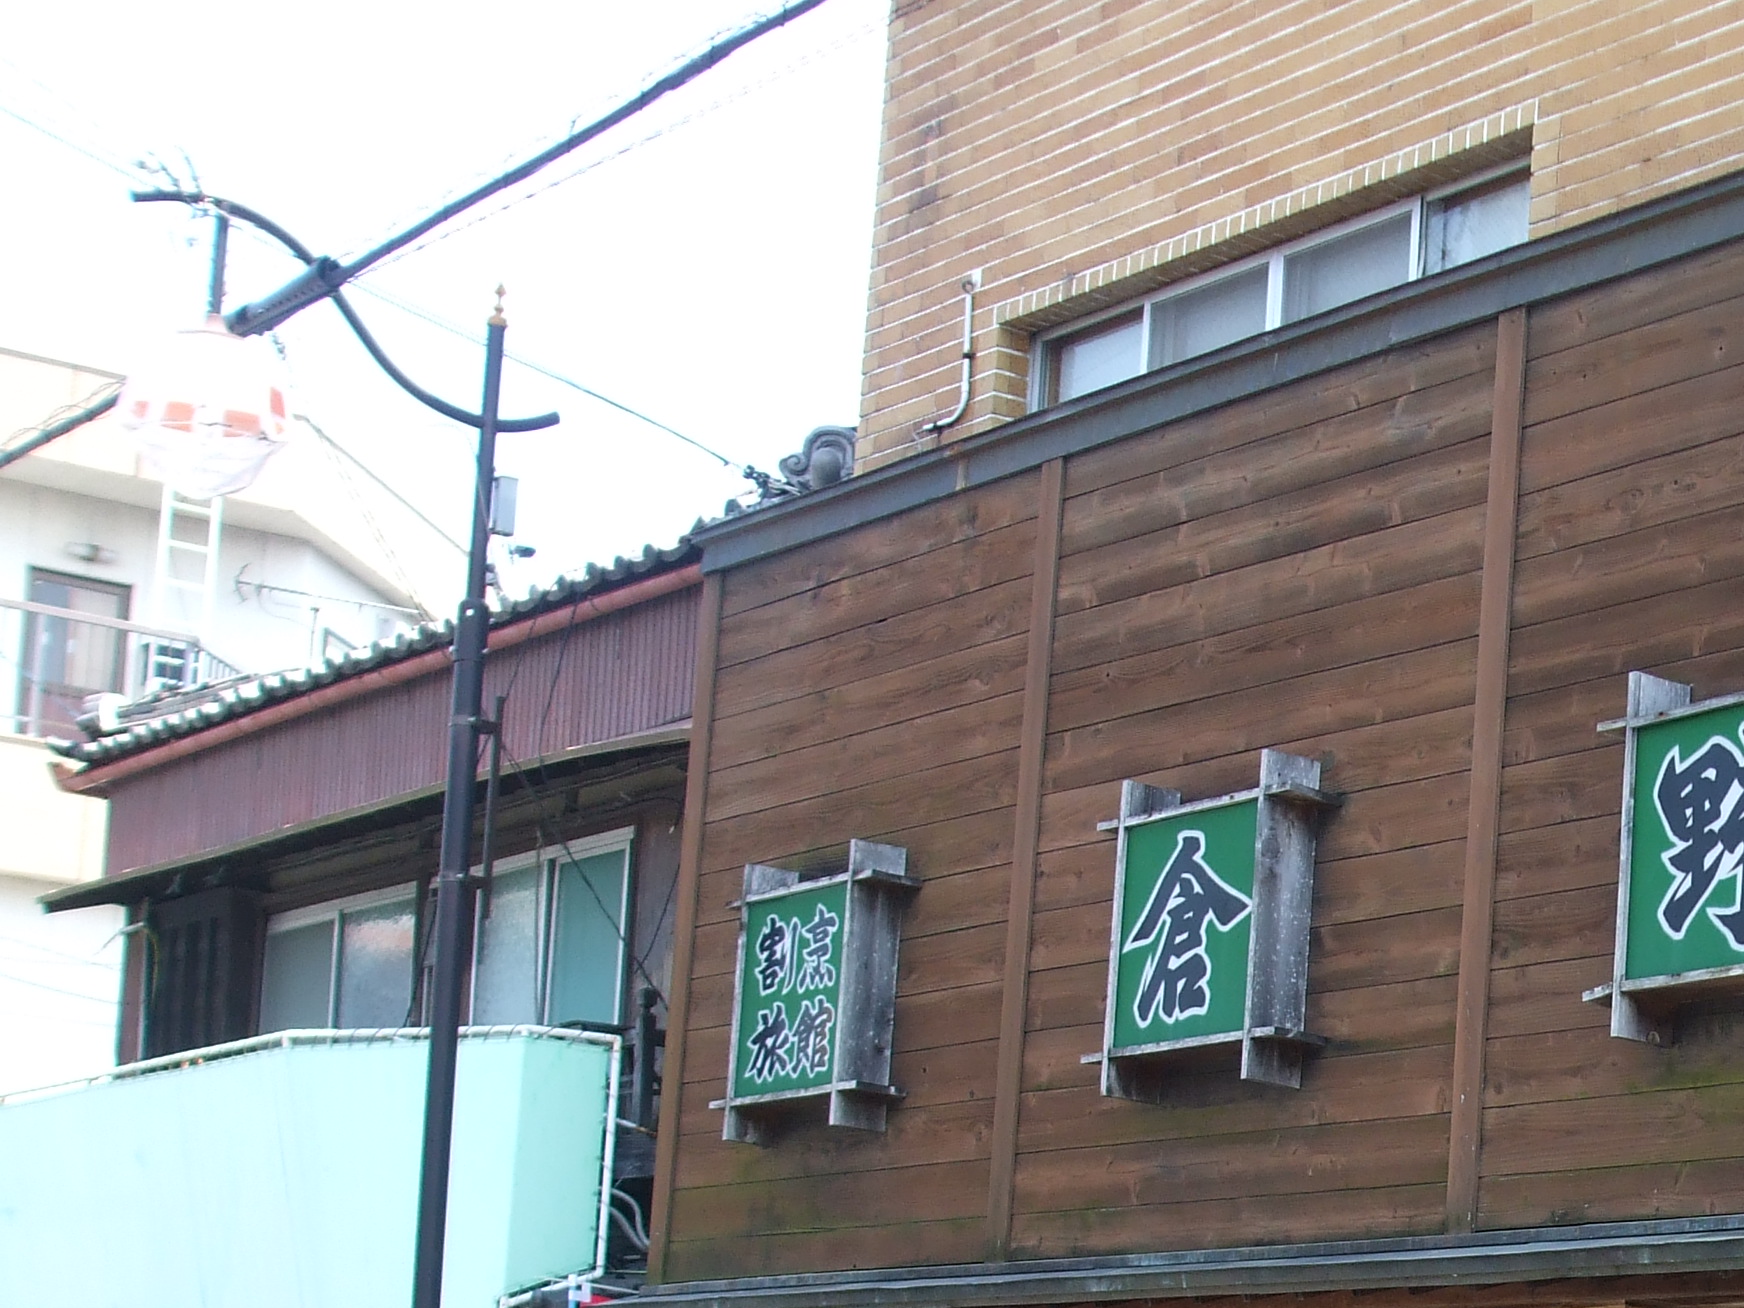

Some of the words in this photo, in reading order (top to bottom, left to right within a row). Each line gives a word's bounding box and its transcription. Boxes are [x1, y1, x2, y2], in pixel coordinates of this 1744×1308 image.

[755, 903, 838, 996] 割烹
[1122, 830, 1252, 1028] 倉
[744, 995, 834, 1083] 旅館
